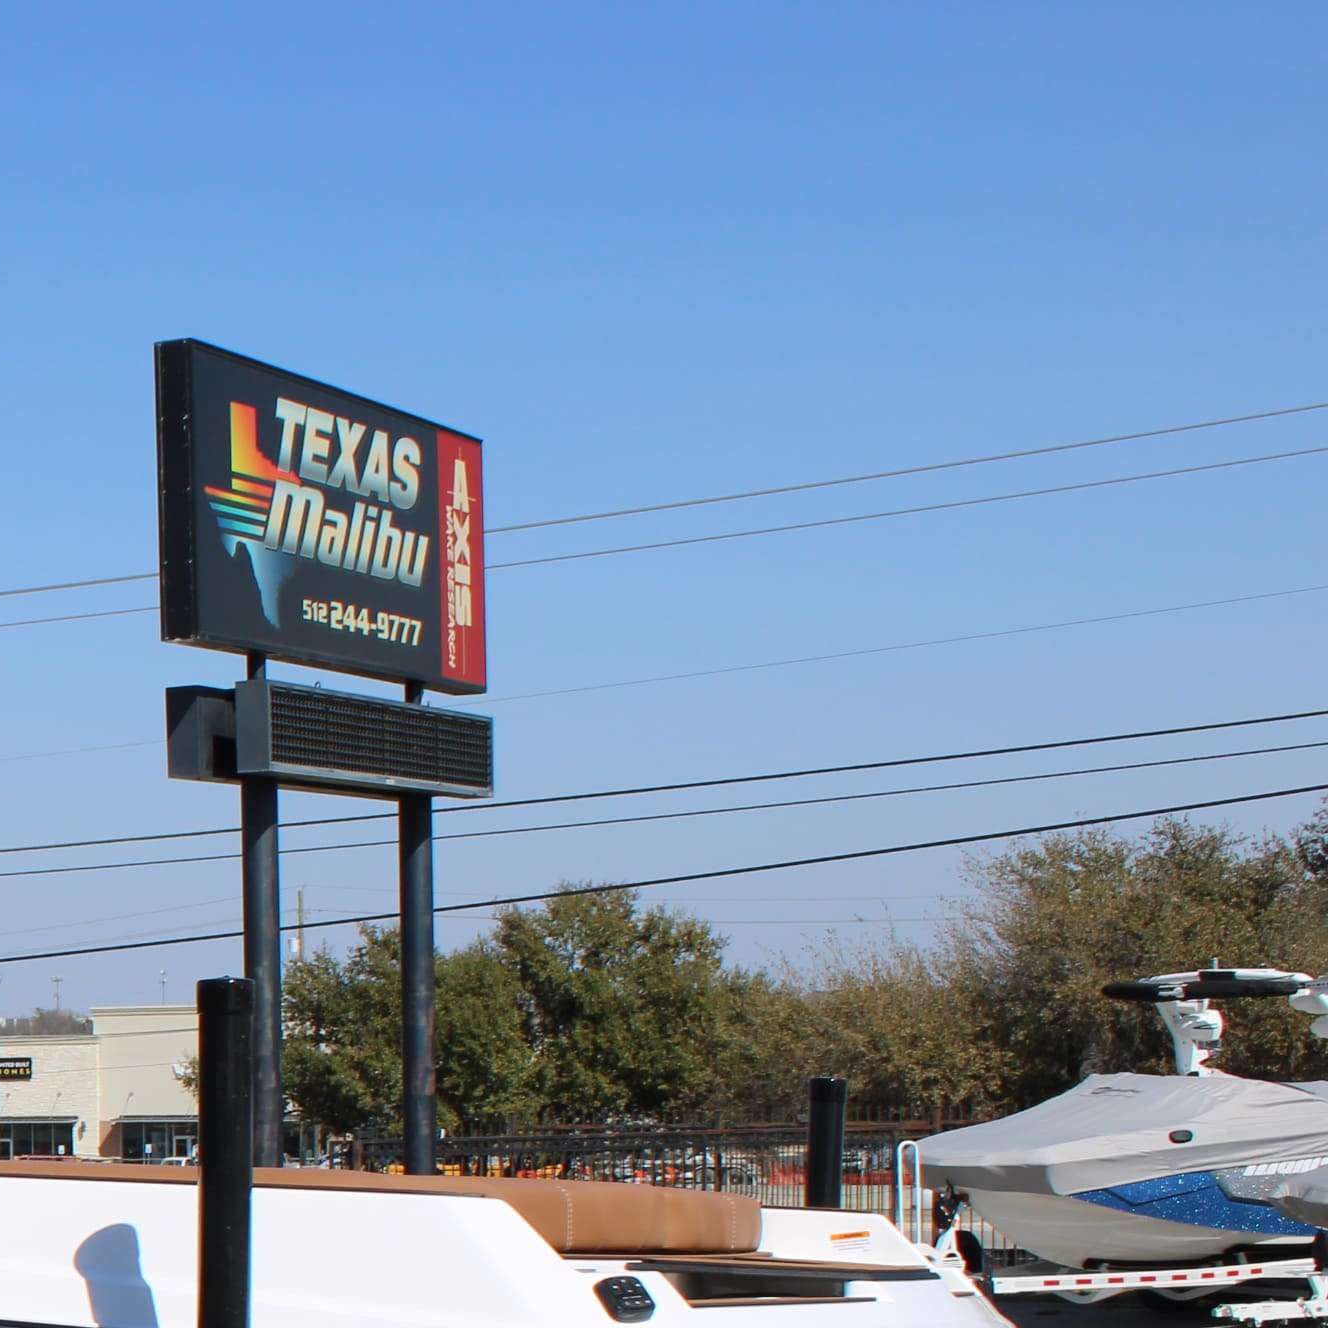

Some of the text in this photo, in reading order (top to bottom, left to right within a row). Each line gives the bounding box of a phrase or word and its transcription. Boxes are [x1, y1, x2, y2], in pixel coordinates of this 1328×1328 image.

[276, 397, 421, 510] TEXAS
[264, 480, 429, 587] Malibu
[445, 505, 457, 669] WAKE RESEARCH
[451, 458, 473, 628] AXIS
[302, 599, 423, 647] 512 244-9777
